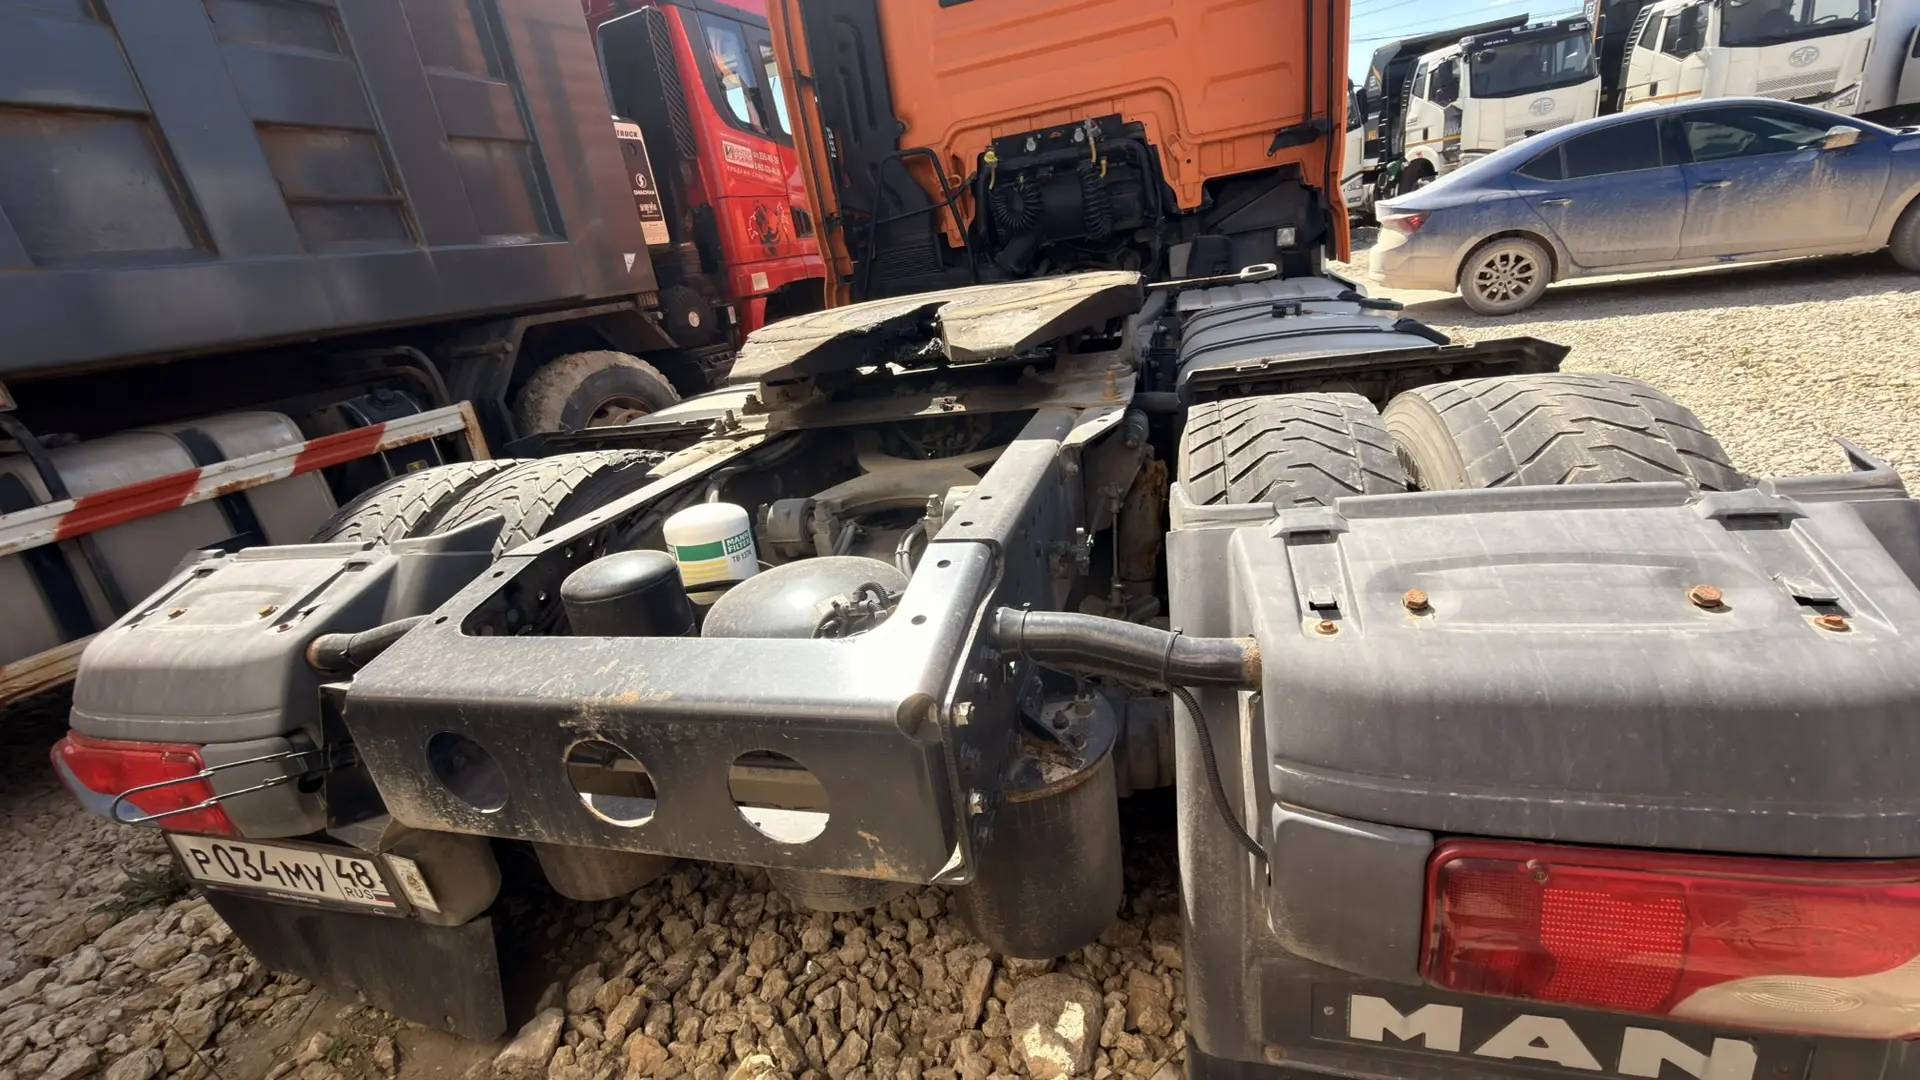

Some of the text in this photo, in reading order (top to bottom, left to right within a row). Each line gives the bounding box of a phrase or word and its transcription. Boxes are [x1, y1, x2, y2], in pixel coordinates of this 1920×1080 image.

[726, 531, 750, 546] MANN
[727, 538, 751, 553] FILTER
[335, 858, 375, 889] 48
[344, 885, 375, 900] RUS
[1349, 994, 1758, 1080] MAN
